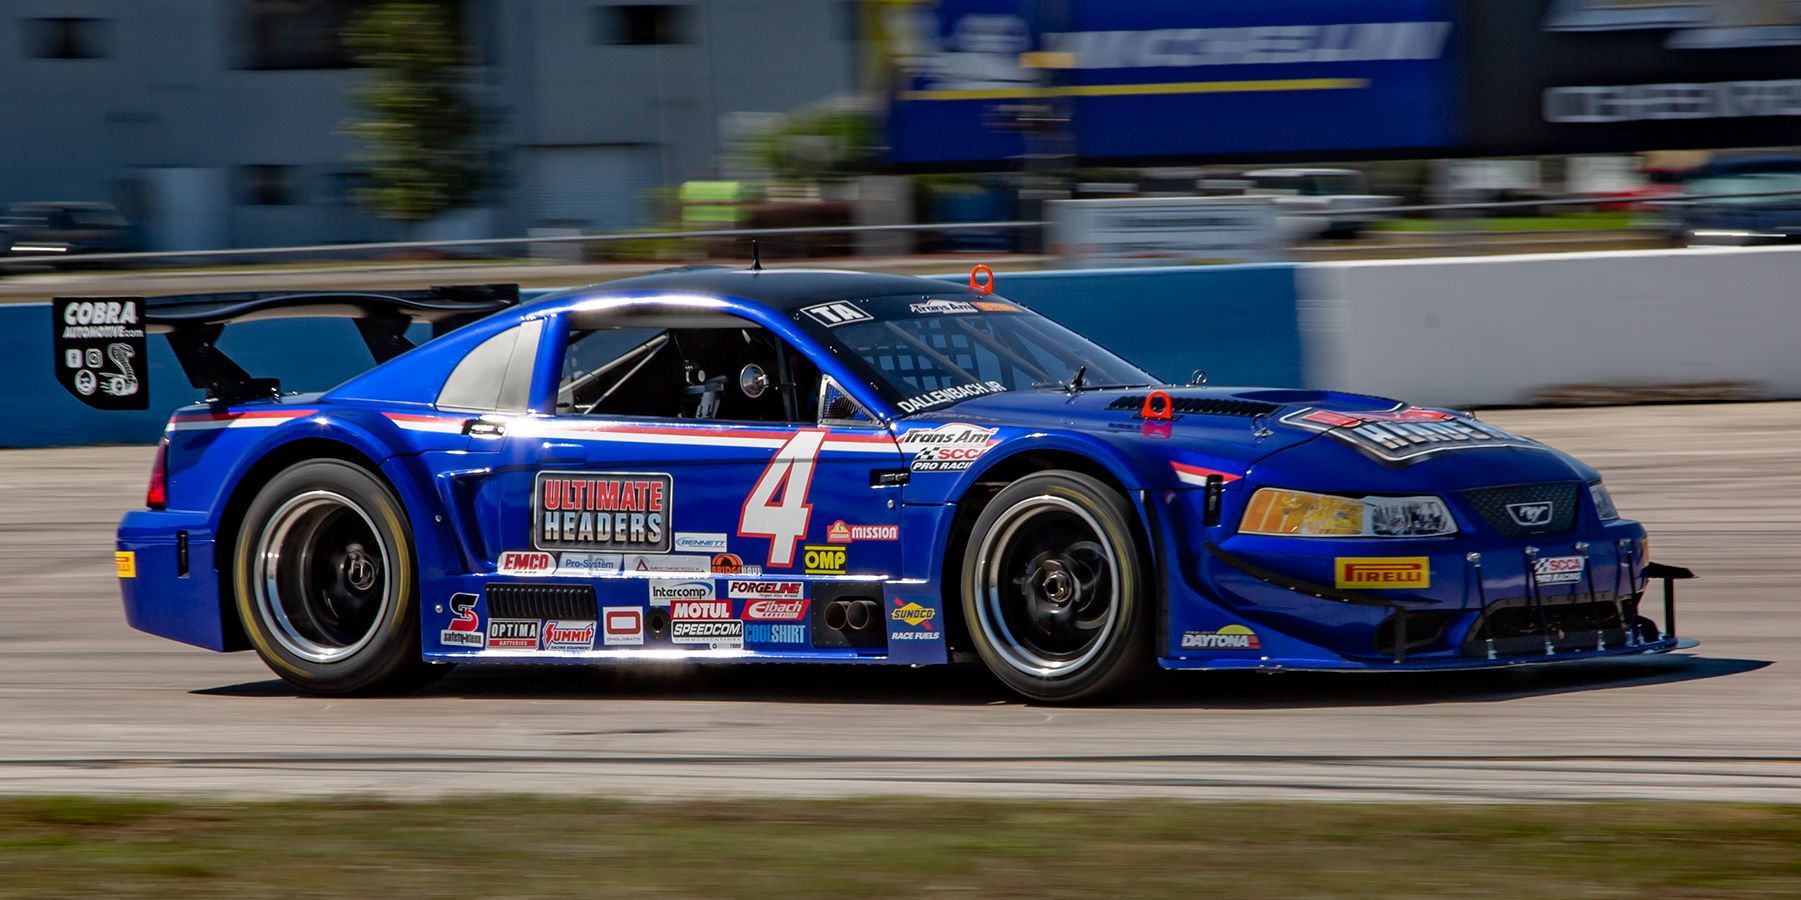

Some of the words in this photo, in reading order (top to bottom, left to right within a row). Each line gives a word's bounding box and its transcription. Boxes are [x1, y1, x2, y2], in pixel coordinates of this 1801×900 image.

[64, 301, 138, 325] COBRA
[809, 304, 864, 322] TA
[897, 383, 986, 413] DALLENBACH
[984, 381, 1007, 393] JR
[904, 430, 956, 443] Trans
[953, 430, 989, 443] Am
[913, 462, 937, 470] PRO
[544, 479, 663, 511] ULTIMATE
[737, 427, 829, 568] 4
[544, 511, 662, 543] HEADERS
[503, 553, 549, 570] EMCO
[565, 559, 614, 571] Pro-System
[804, 551, 846, 569] OMP
[1550, 559, 1581, 570] SCCA
[1344, 563, 1422, 582] PIRELLI
[652, 586, 706, 599] Intercomp
[730, 581, 802, 594] FORGELINE
[673, 602, 731, 619] MOTUL
[748, 600, 803, 618] Eibach
[893, 609, 933, 619] SUNOCO
[491, 623, 536, 638] OPTIMA
[745, 624, 806, 643] COOLSHIRT
[1181, 634, 1250, 647] DAYTONA
